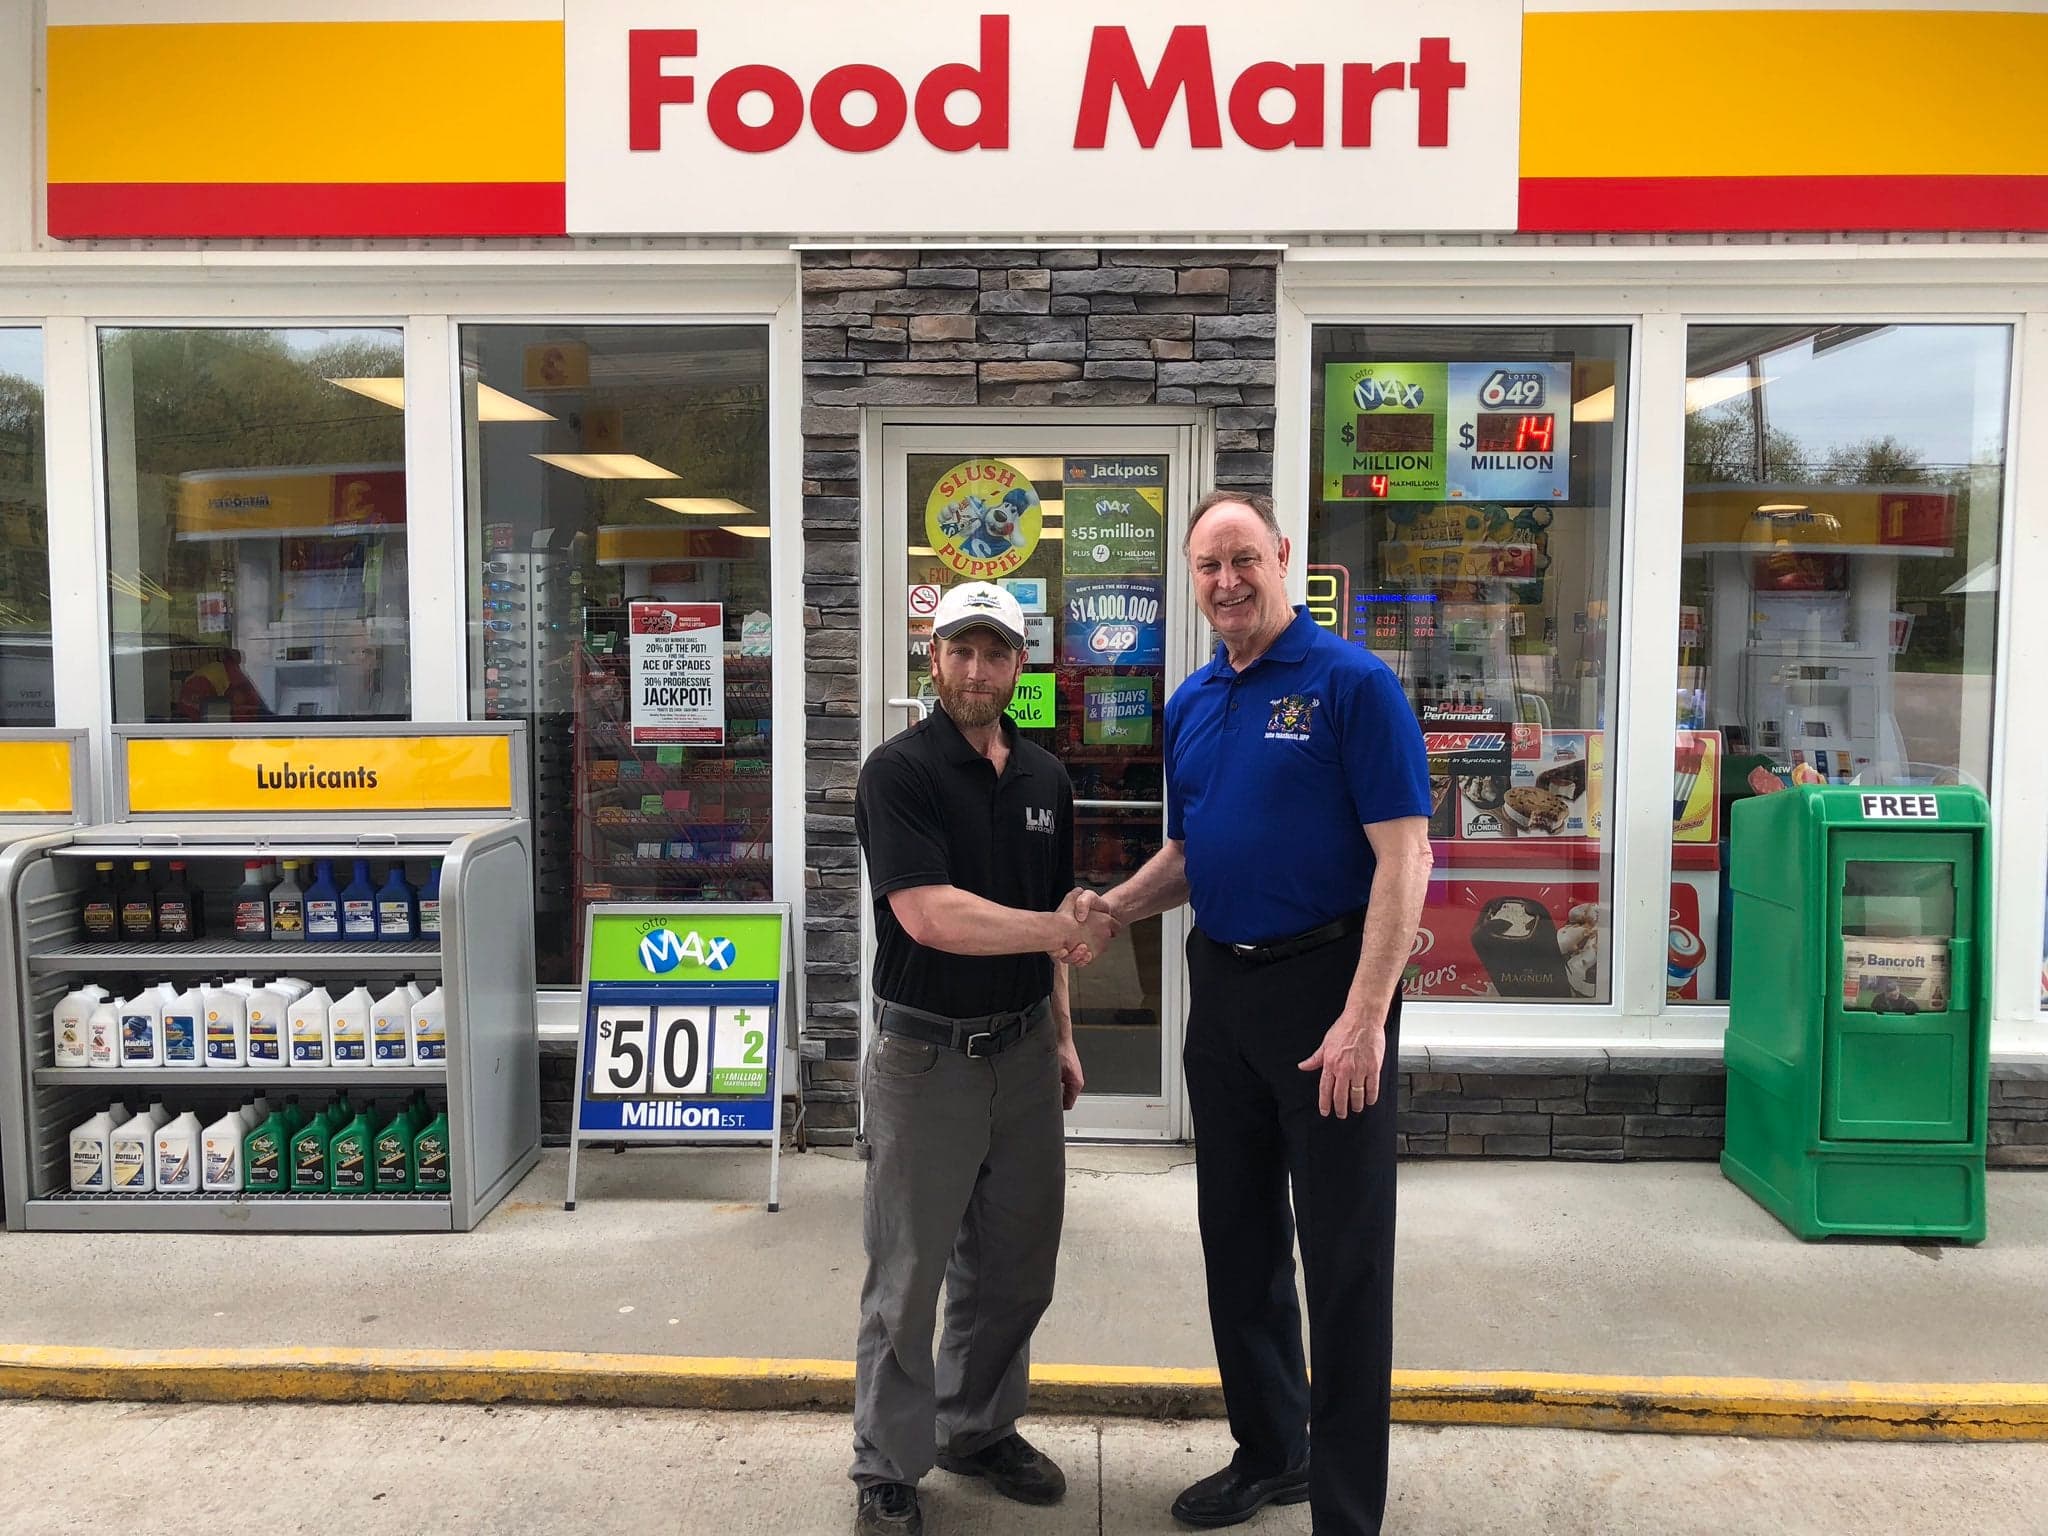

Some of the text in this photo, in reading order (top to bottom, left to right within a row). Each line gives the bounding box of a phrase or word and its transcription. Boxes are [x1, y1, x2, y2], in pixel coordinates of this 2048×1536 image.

[629, 14, 1466, 152] Food Mart
[1349, 369, 1374, 382] Lotto
[1355, 378, 1420, 409] MAX
[1341, 422, 1355, 446] $
[1459, 422, 1475, 450] $
[1516, 416, 1552, 451] 14
[1353, 455, 1429, 470] MILLION
[1471, 455, 1553, 470] MILLION
[1091, 463, 1158, 479] Jackpots
[940, 464, 1016, 498] SLUSH
[1372, 475, 1387, 497] 4
[1095, 500, 1130, 516] MAX
[1071, 523, 1155, 540] $55 million
[929, 568, 951, 583] EXIT
[1070, 594, 1159, 625] $14,000,000
[1024, 618, 1043, 626] KING
[646, 644, 707, 653] 20% OF THE POT!
[910, 641, 930, 656] AT
[643, 660, 711, 671] ACE OF SPADES
[644, 677, 712, 687] 30% PROGRESSIVE
[643, 687, 712, 706] JACKPOT!
[1090, 689, 1146, 705] TUESDAYS
[1007, 703, 1042, 720] Sale
[1089, 704, 1145, 719] & FRIDAYS
[1439, 702, 1483, 713] Pulse
[1423, 712, 1494, 720] Performance
[1424, 733, 1506, 753] AMSOIL
[257, 761, 378, 789] Lubricants
[1863, 796, 1937, 817] FREE
[1467, 823, 1503, 837] KLONDIKE
[635, 917, 668, 935] Lotto
[640, 928, 731, 973] MAX
[1867, 953, 1926, 968] Bancroft
[1402, 963, 1457, 995] eyers
[1501, 973, 1554, 984] MAGNUM
[743, 1030, 765, 1065] 2
[730, 1072, 763, 1081] MILLION
[621, 1101, 746, 1128] Million EST.
